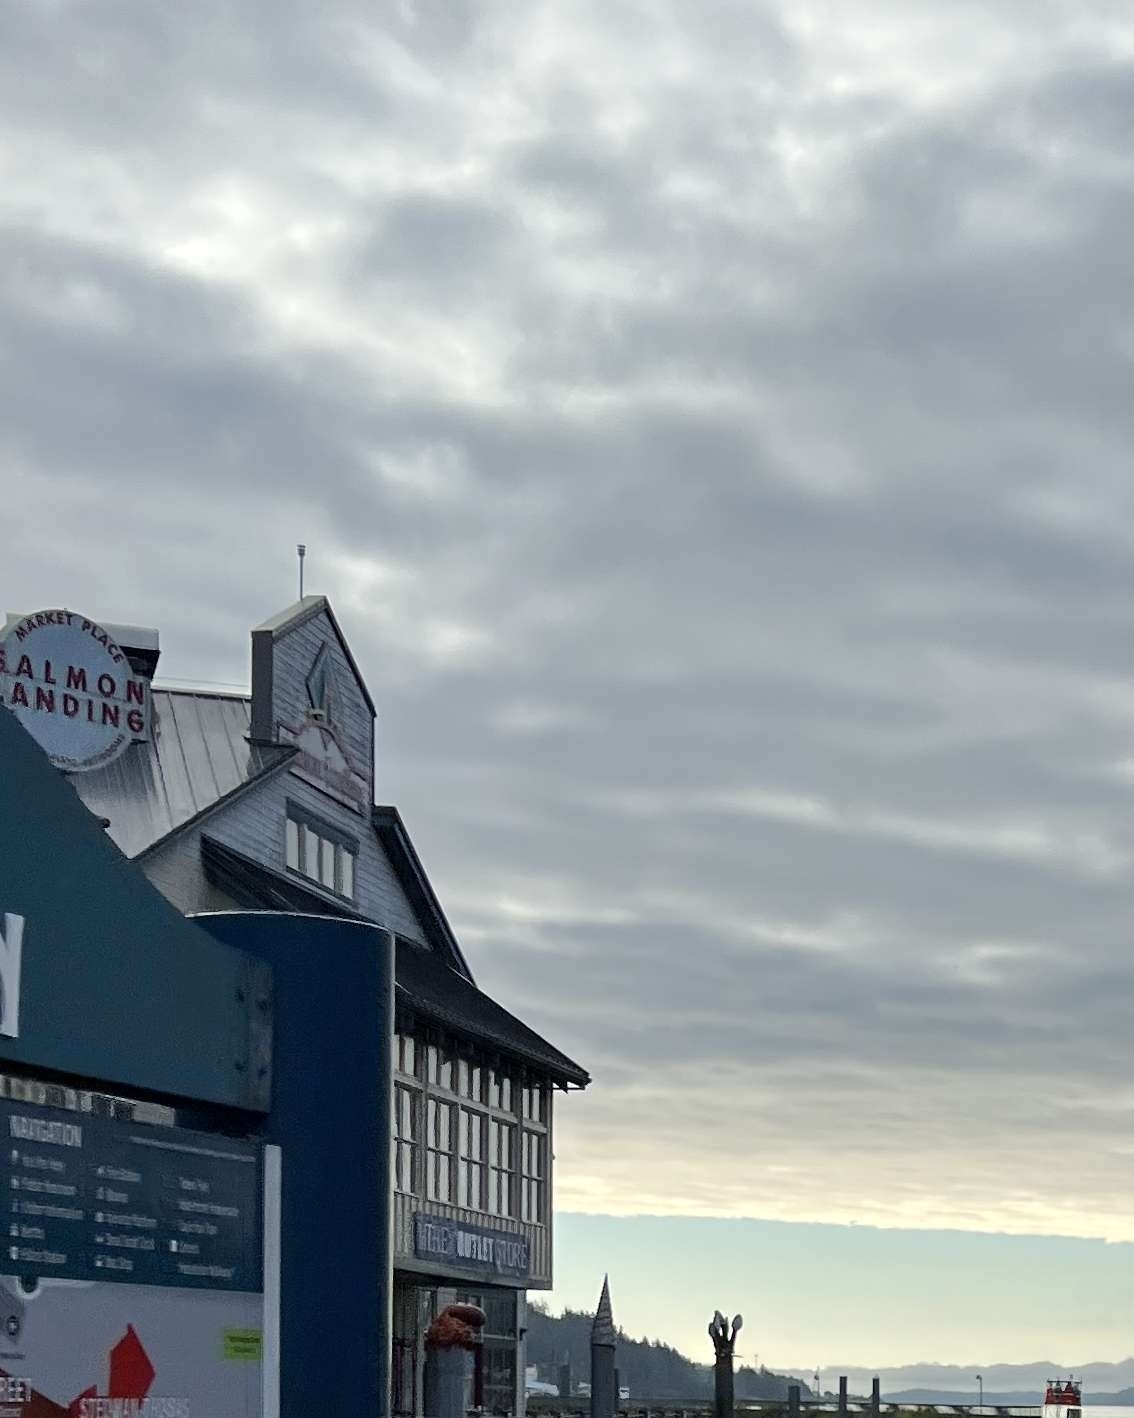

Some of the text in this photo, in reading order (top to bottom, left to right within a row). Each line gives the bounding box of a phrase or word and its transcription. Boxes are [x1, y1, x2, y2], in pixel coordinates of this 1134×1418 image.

[15, 613, 124, 664] MARKET PLACE
[8, 681, 144, 733] ANDING
